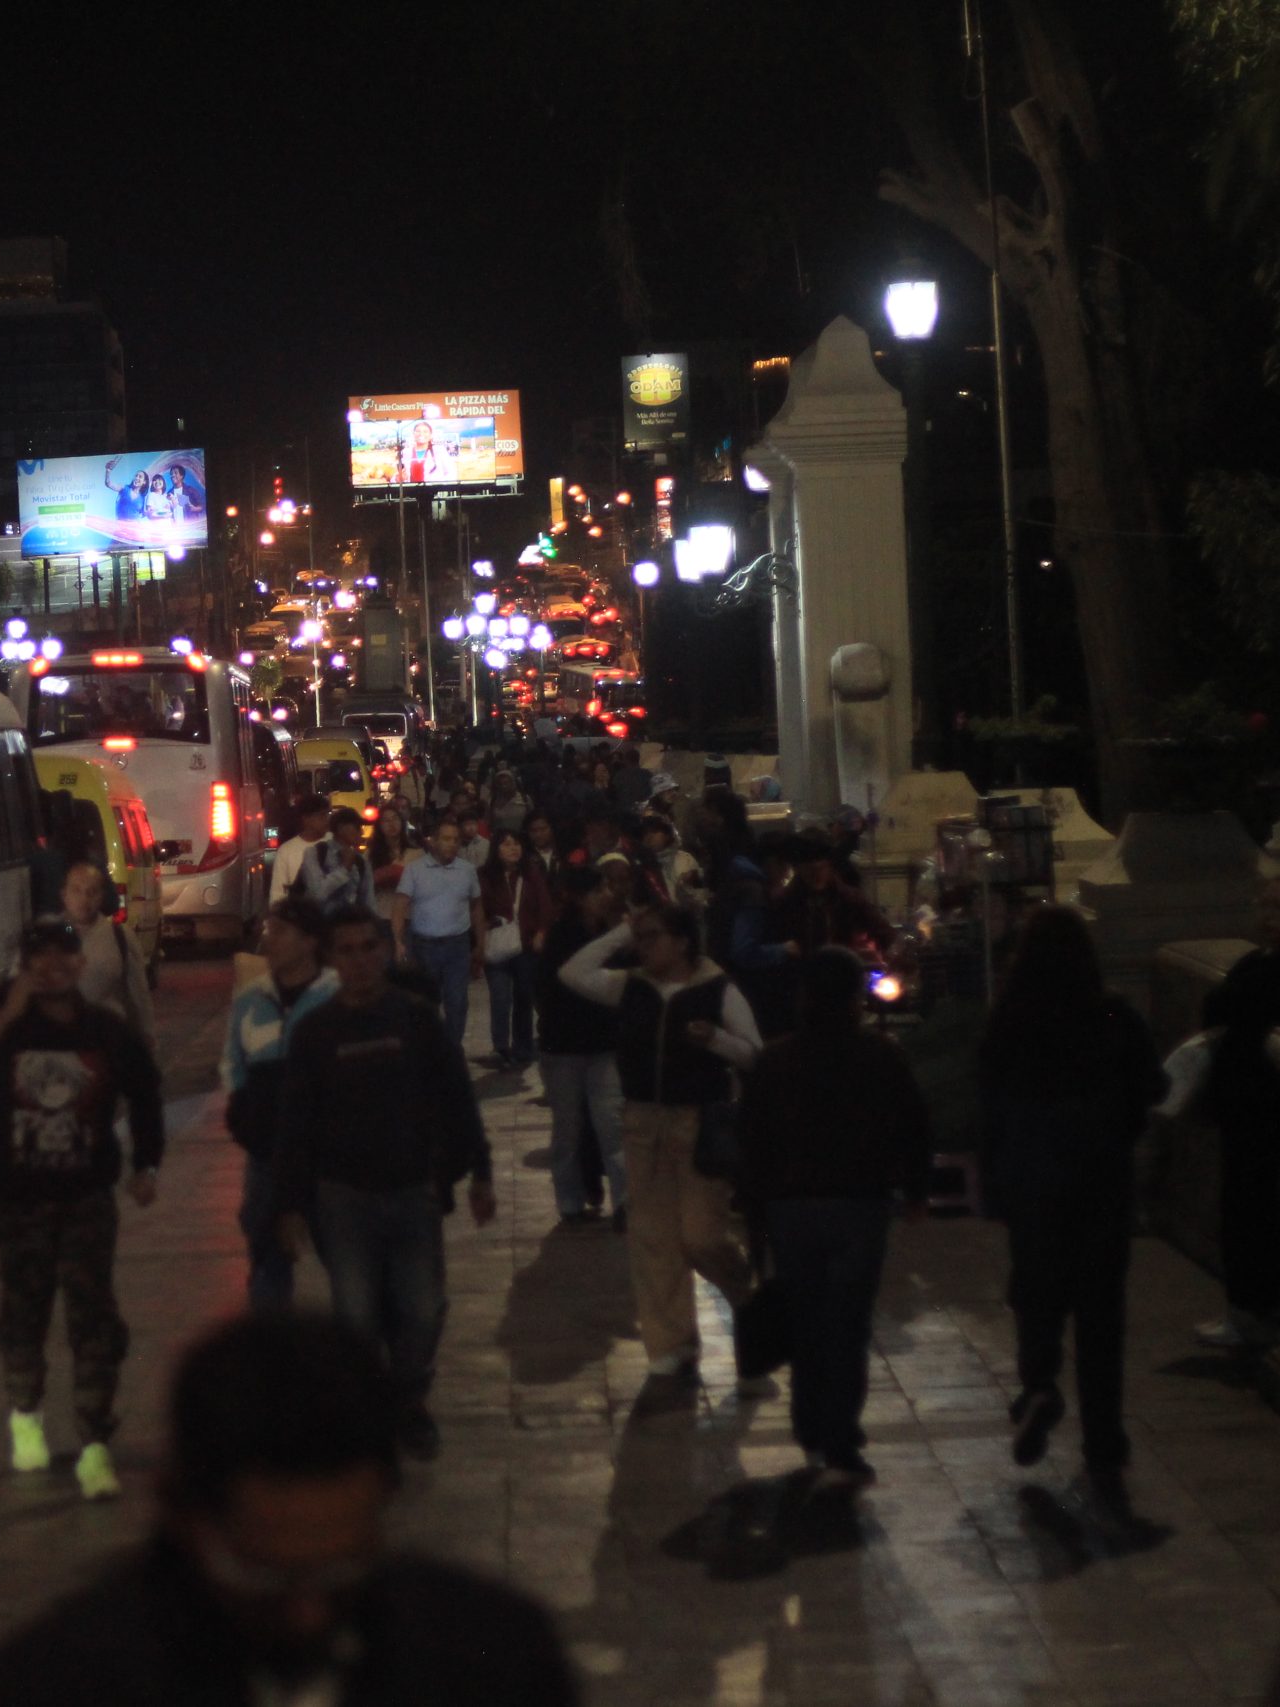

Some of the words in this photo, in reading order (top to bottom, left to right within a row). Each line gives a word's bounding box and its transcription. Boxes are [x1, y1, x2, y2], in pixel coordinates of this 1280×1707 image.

[445, 396, 457, 406] LA
[458, 394, 486, 405] PIZZA
[487, 392, 509, 404] MÁS
[449, 403, 486, 417] RÁPIDA
[487, 405, 506, 415] DEL
[32, 493, 67, 504] Movistar
[69, 492, 90, 502] Total
